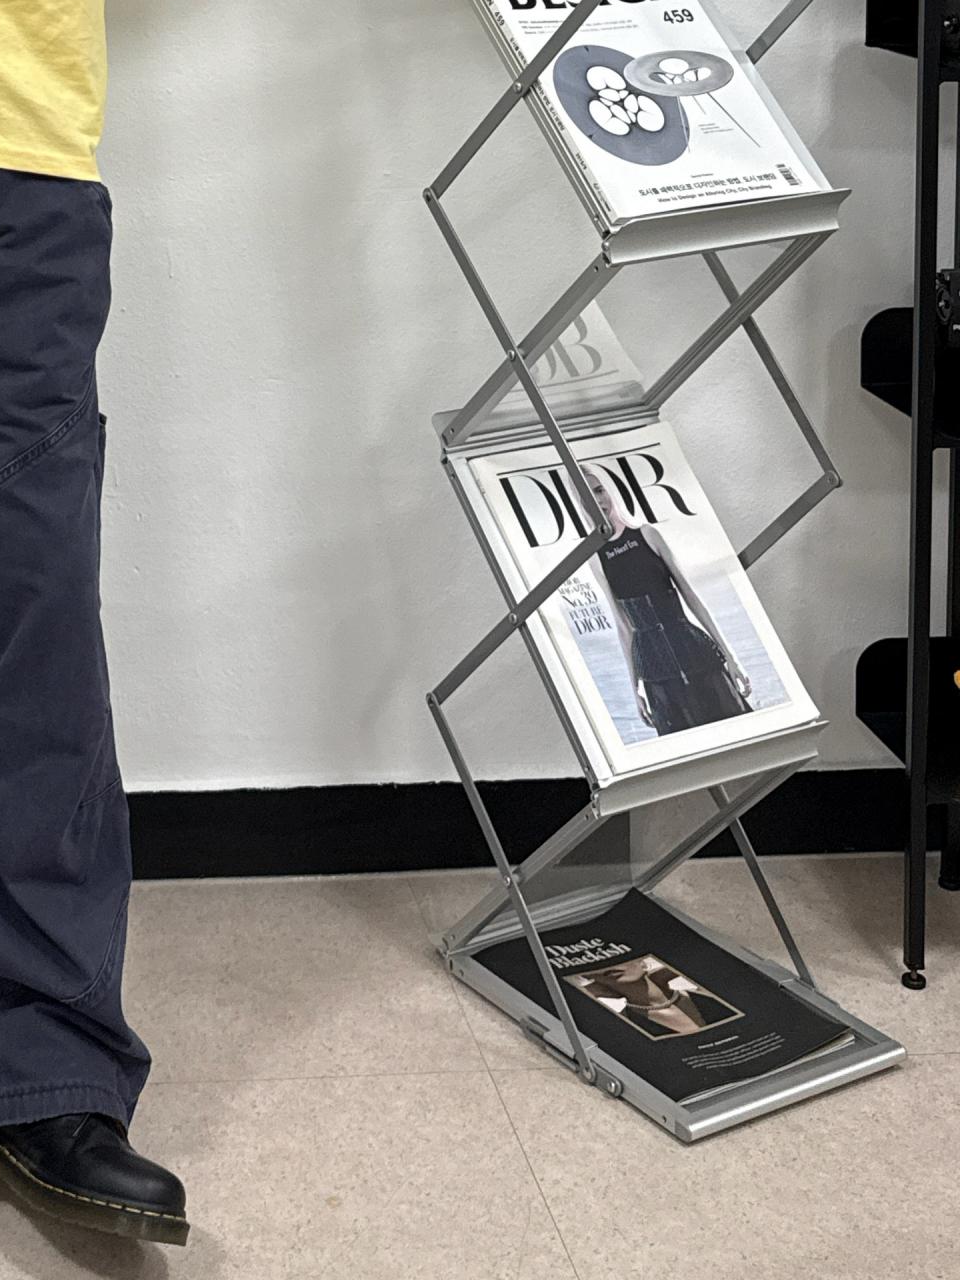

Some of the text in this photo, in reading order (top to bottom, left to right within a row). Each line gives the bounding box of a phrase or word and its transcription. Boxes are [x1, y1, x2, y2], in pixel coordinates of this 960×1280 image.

[663, 8, 695, 25] 459
[499, 453, 697, 547] DIOR
[574, 615, 613, 635] DIOR
